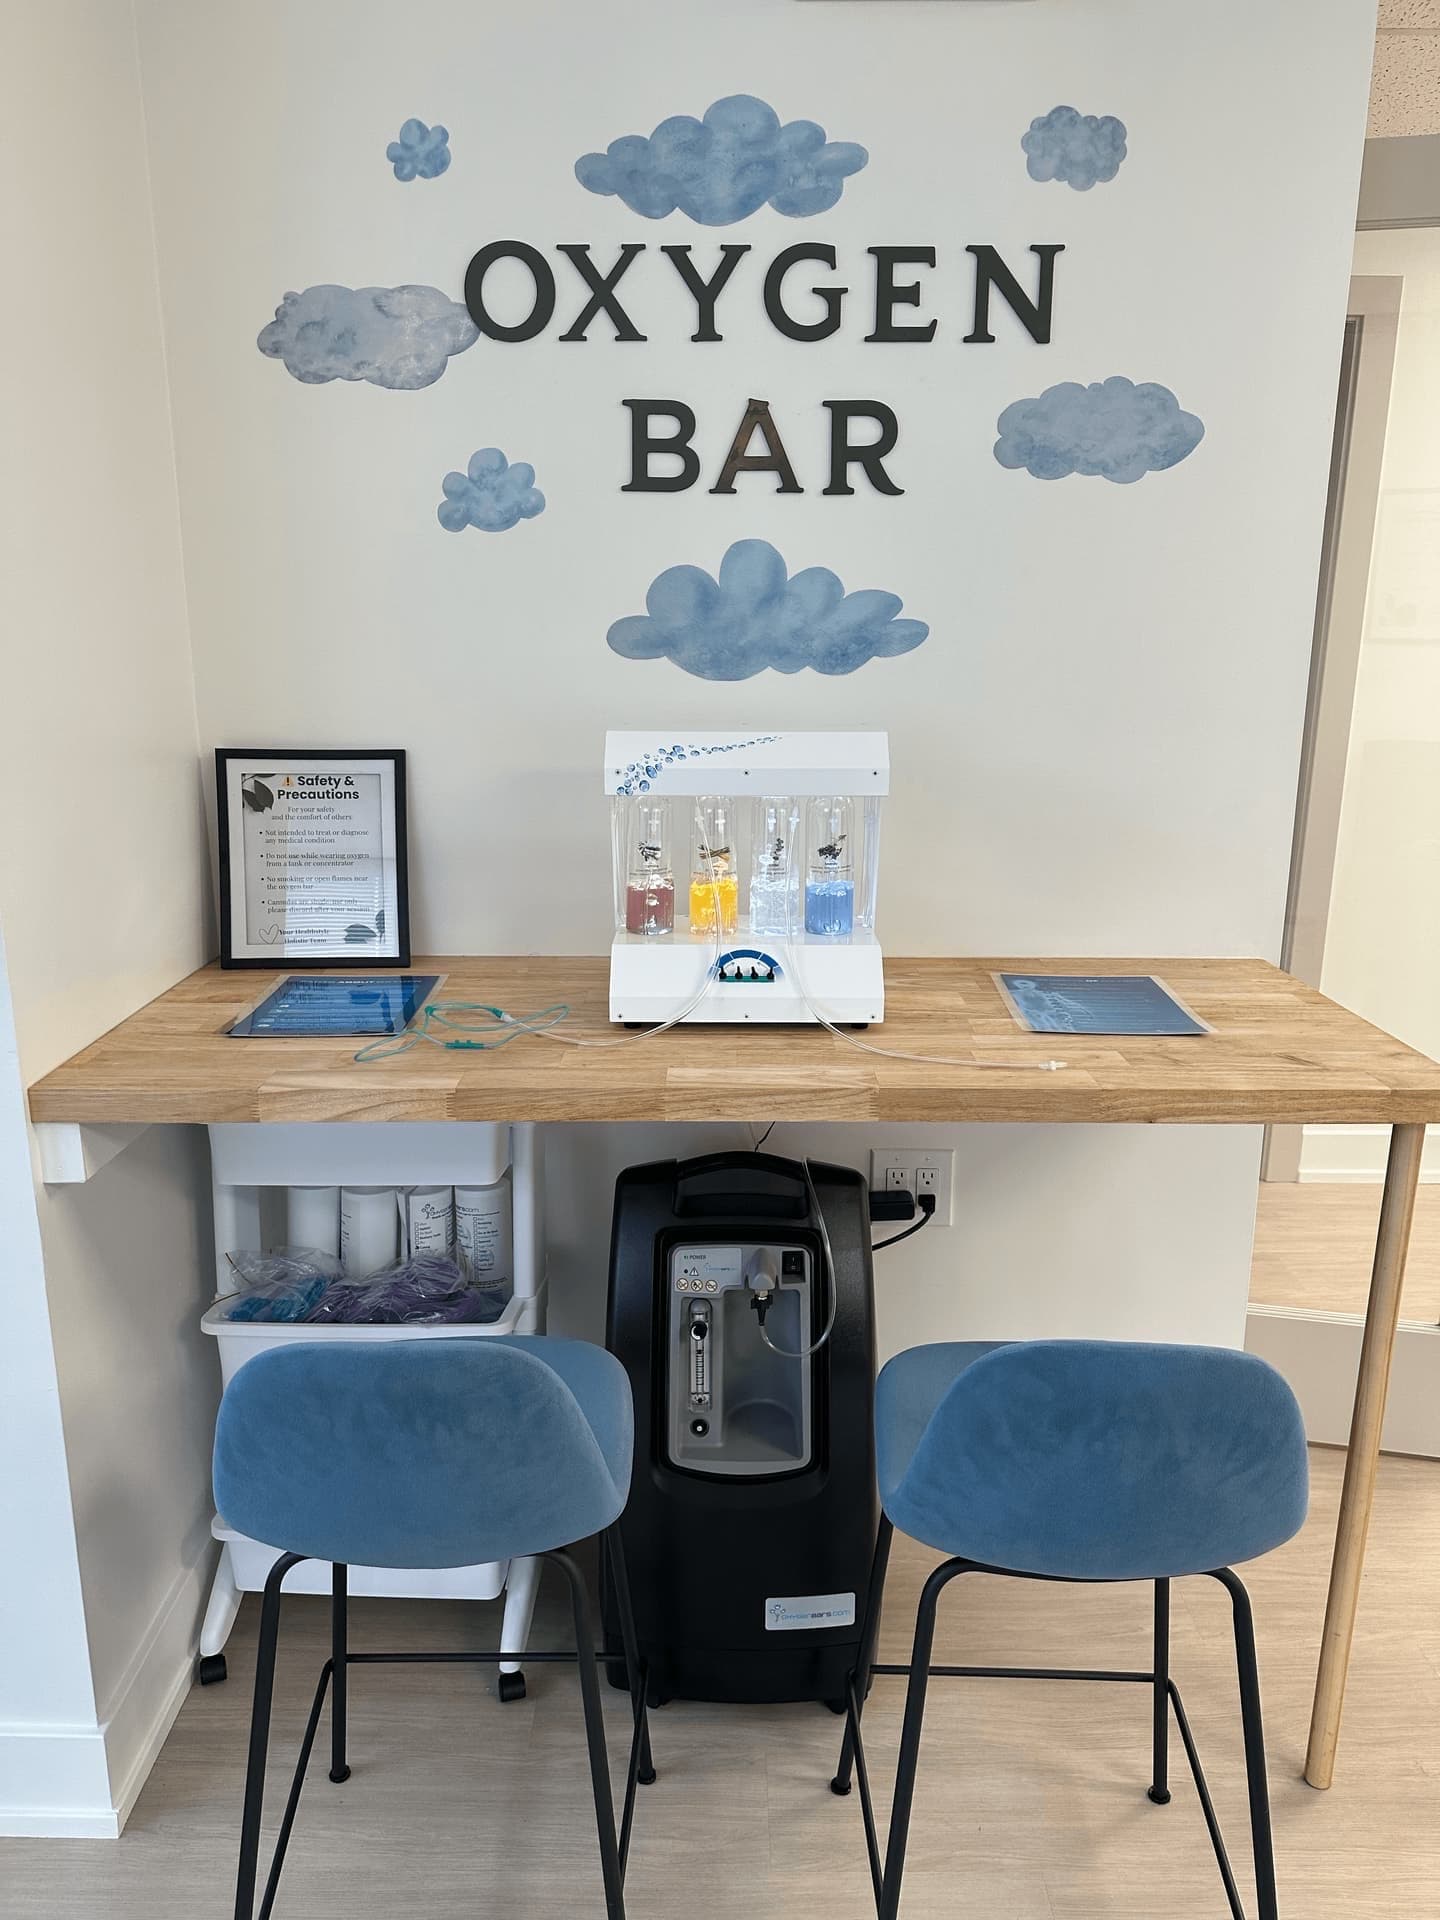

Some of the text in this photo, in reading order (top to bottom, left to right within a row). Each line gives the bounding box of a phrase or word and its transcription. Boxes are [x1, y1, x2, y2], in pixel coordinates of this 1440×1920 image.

[464, 239, 1065, 344] OXYGEN
[621, 398, 905, 496] BAR
[277, 789, 359, 800] Precautions
[298, 776, 354, 788] Safety &
